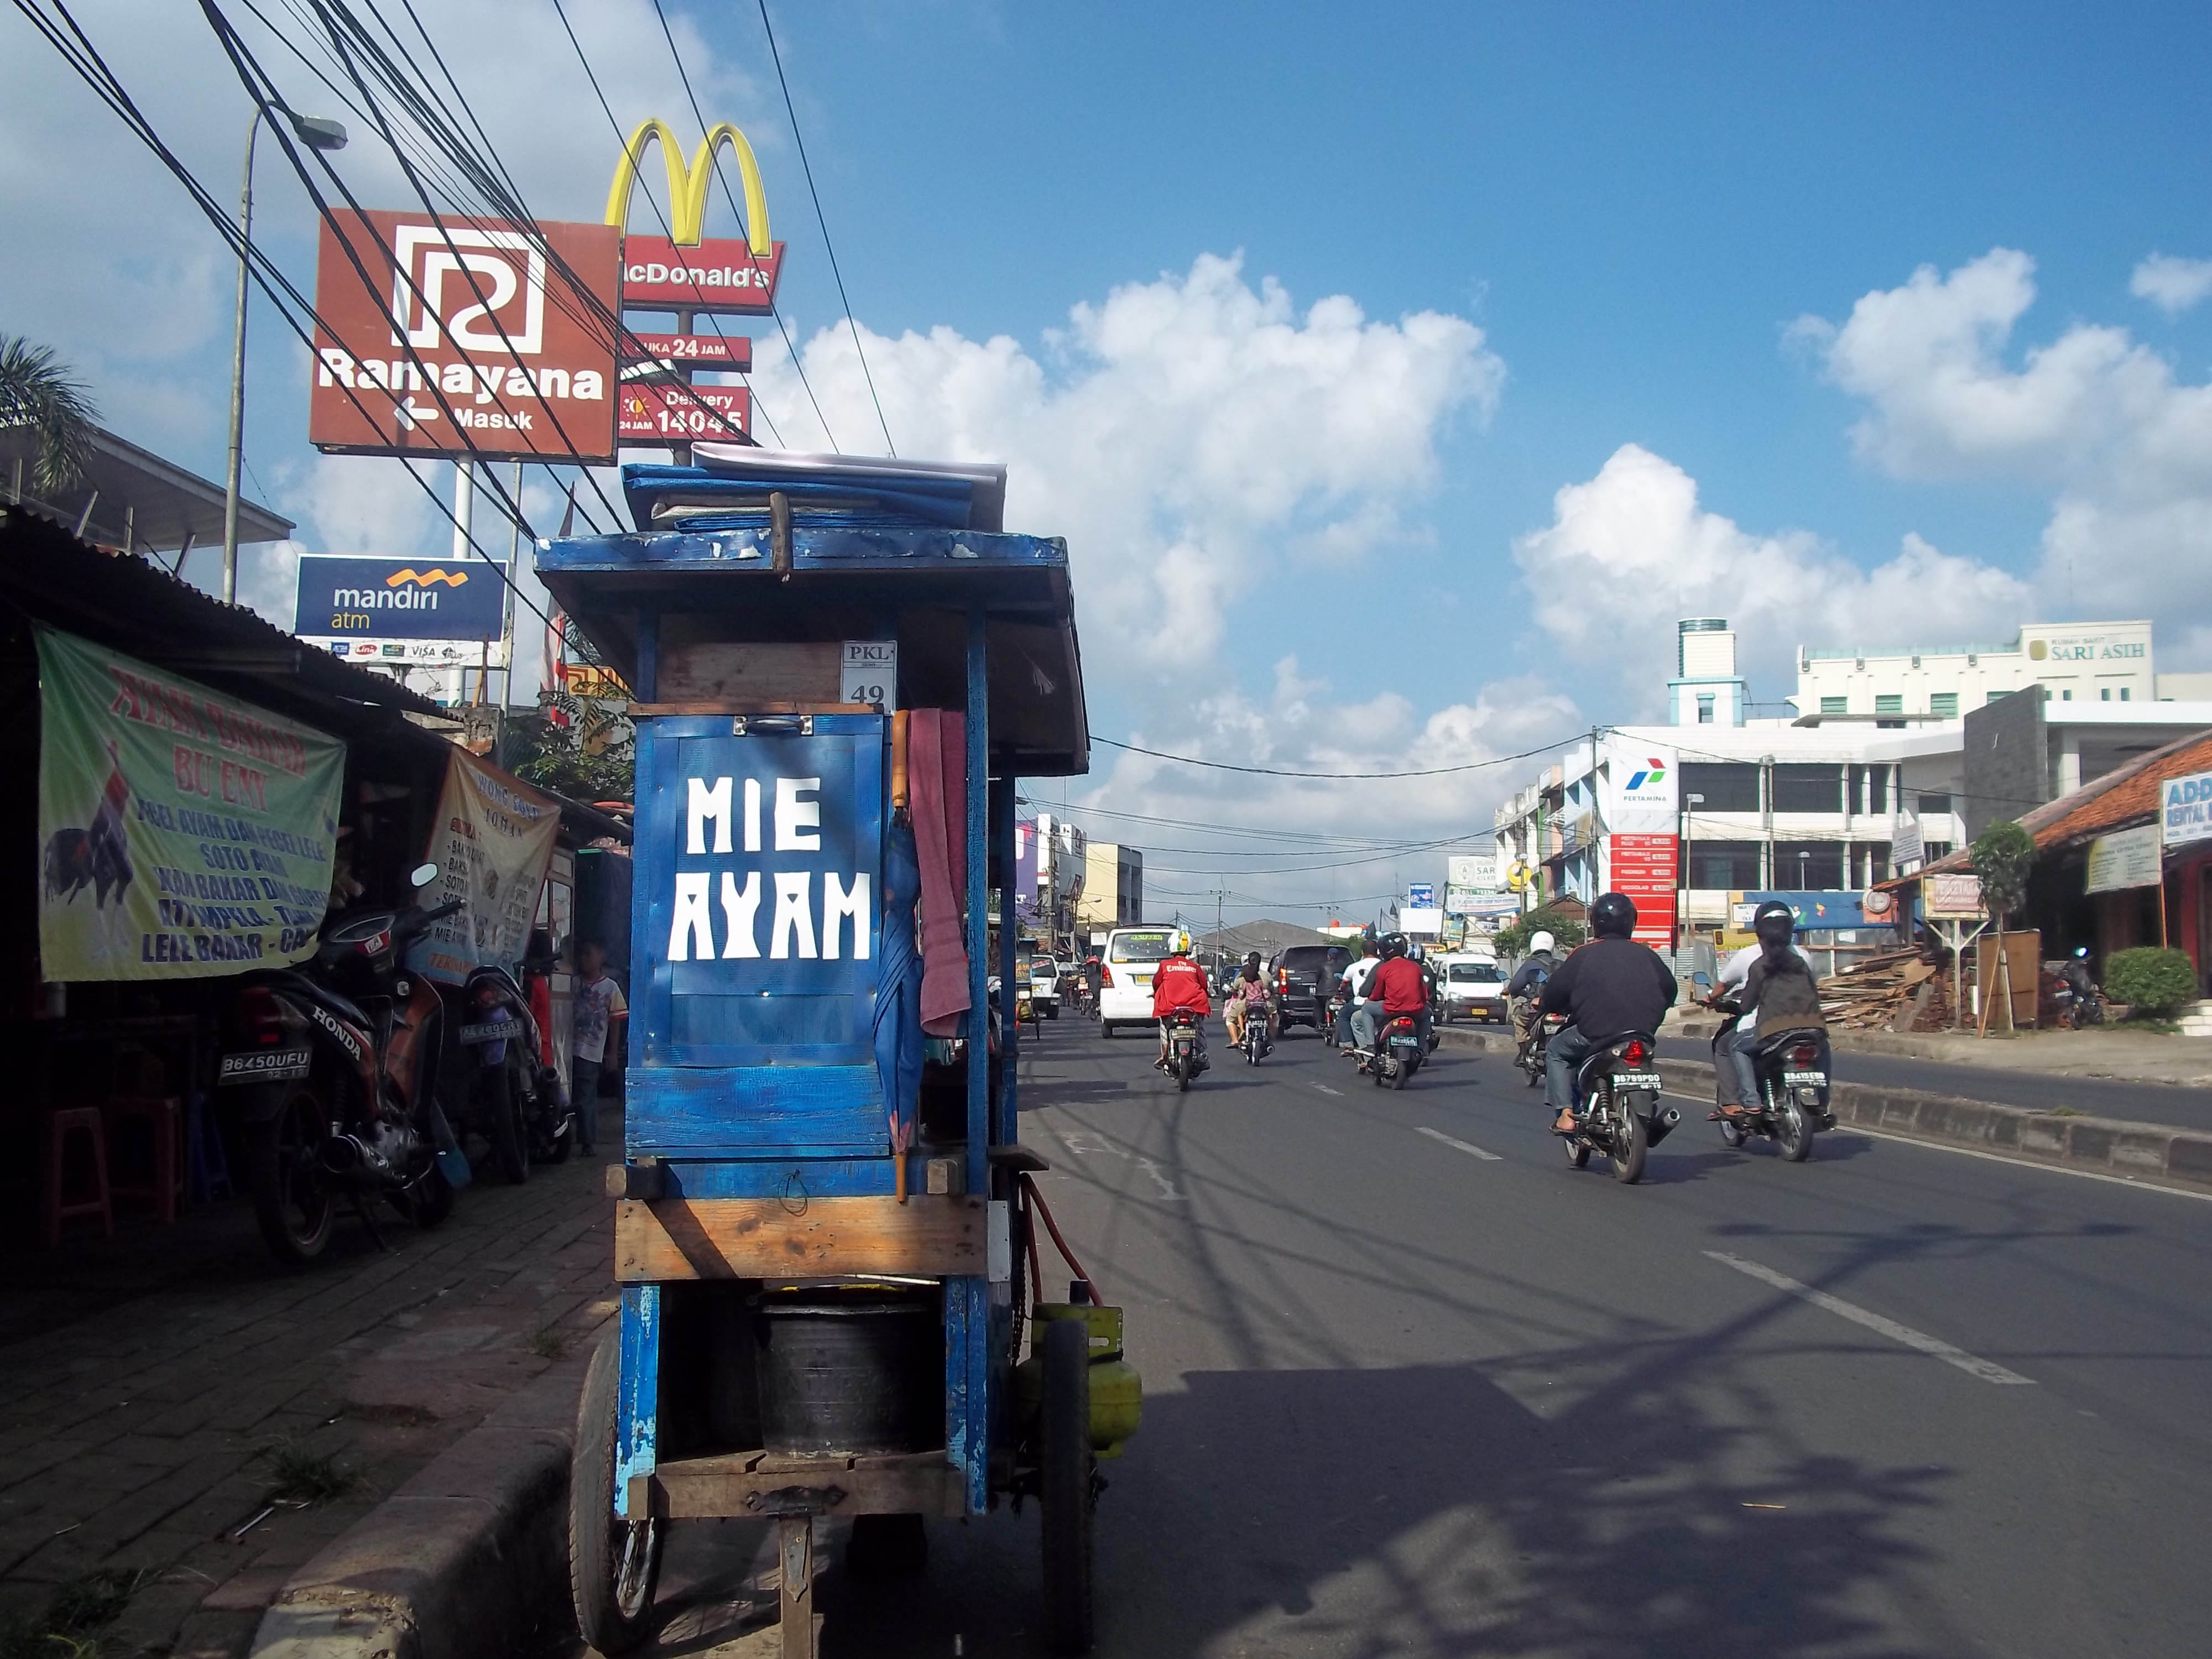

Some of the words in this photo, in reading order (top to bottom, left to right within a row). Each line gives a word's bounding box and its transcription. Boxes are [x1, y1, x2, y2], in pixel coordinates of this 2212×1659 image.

[635, 342, 670, 353] UKA
[672, 338, 698, 357] 24
[701, 345, 726, 355] JAM
[319, 348, 604, 404] Ramayana
[454, 409, 533, 431] Masuk
[619, 421, 631, 430] 24
[632, 421, 653, 430] JAM
[657, 410, 743, 434] 14045
[333, 584, 439, 610] mandiri
[331, 611, 371, 629] atm
[412, 646, 436, 656] VISA
[850, 646, 889, 660] PKL
[2052, 645, 2094, 661] SARI
[2100, 643, 2145, 659] ASIH
[851, 685, 884, 704] 49
[174, 744, 213, 797] BU
[686, 776, 821, 854] MIE
[200, 842, 249, 872] SOTO
[195, 873, 261, 901] BAKAR
[667, 872, 870, 961] AYAM
[142, 933, 194, 962] LELE
[312, 1005, 362, 1062] HONDA
